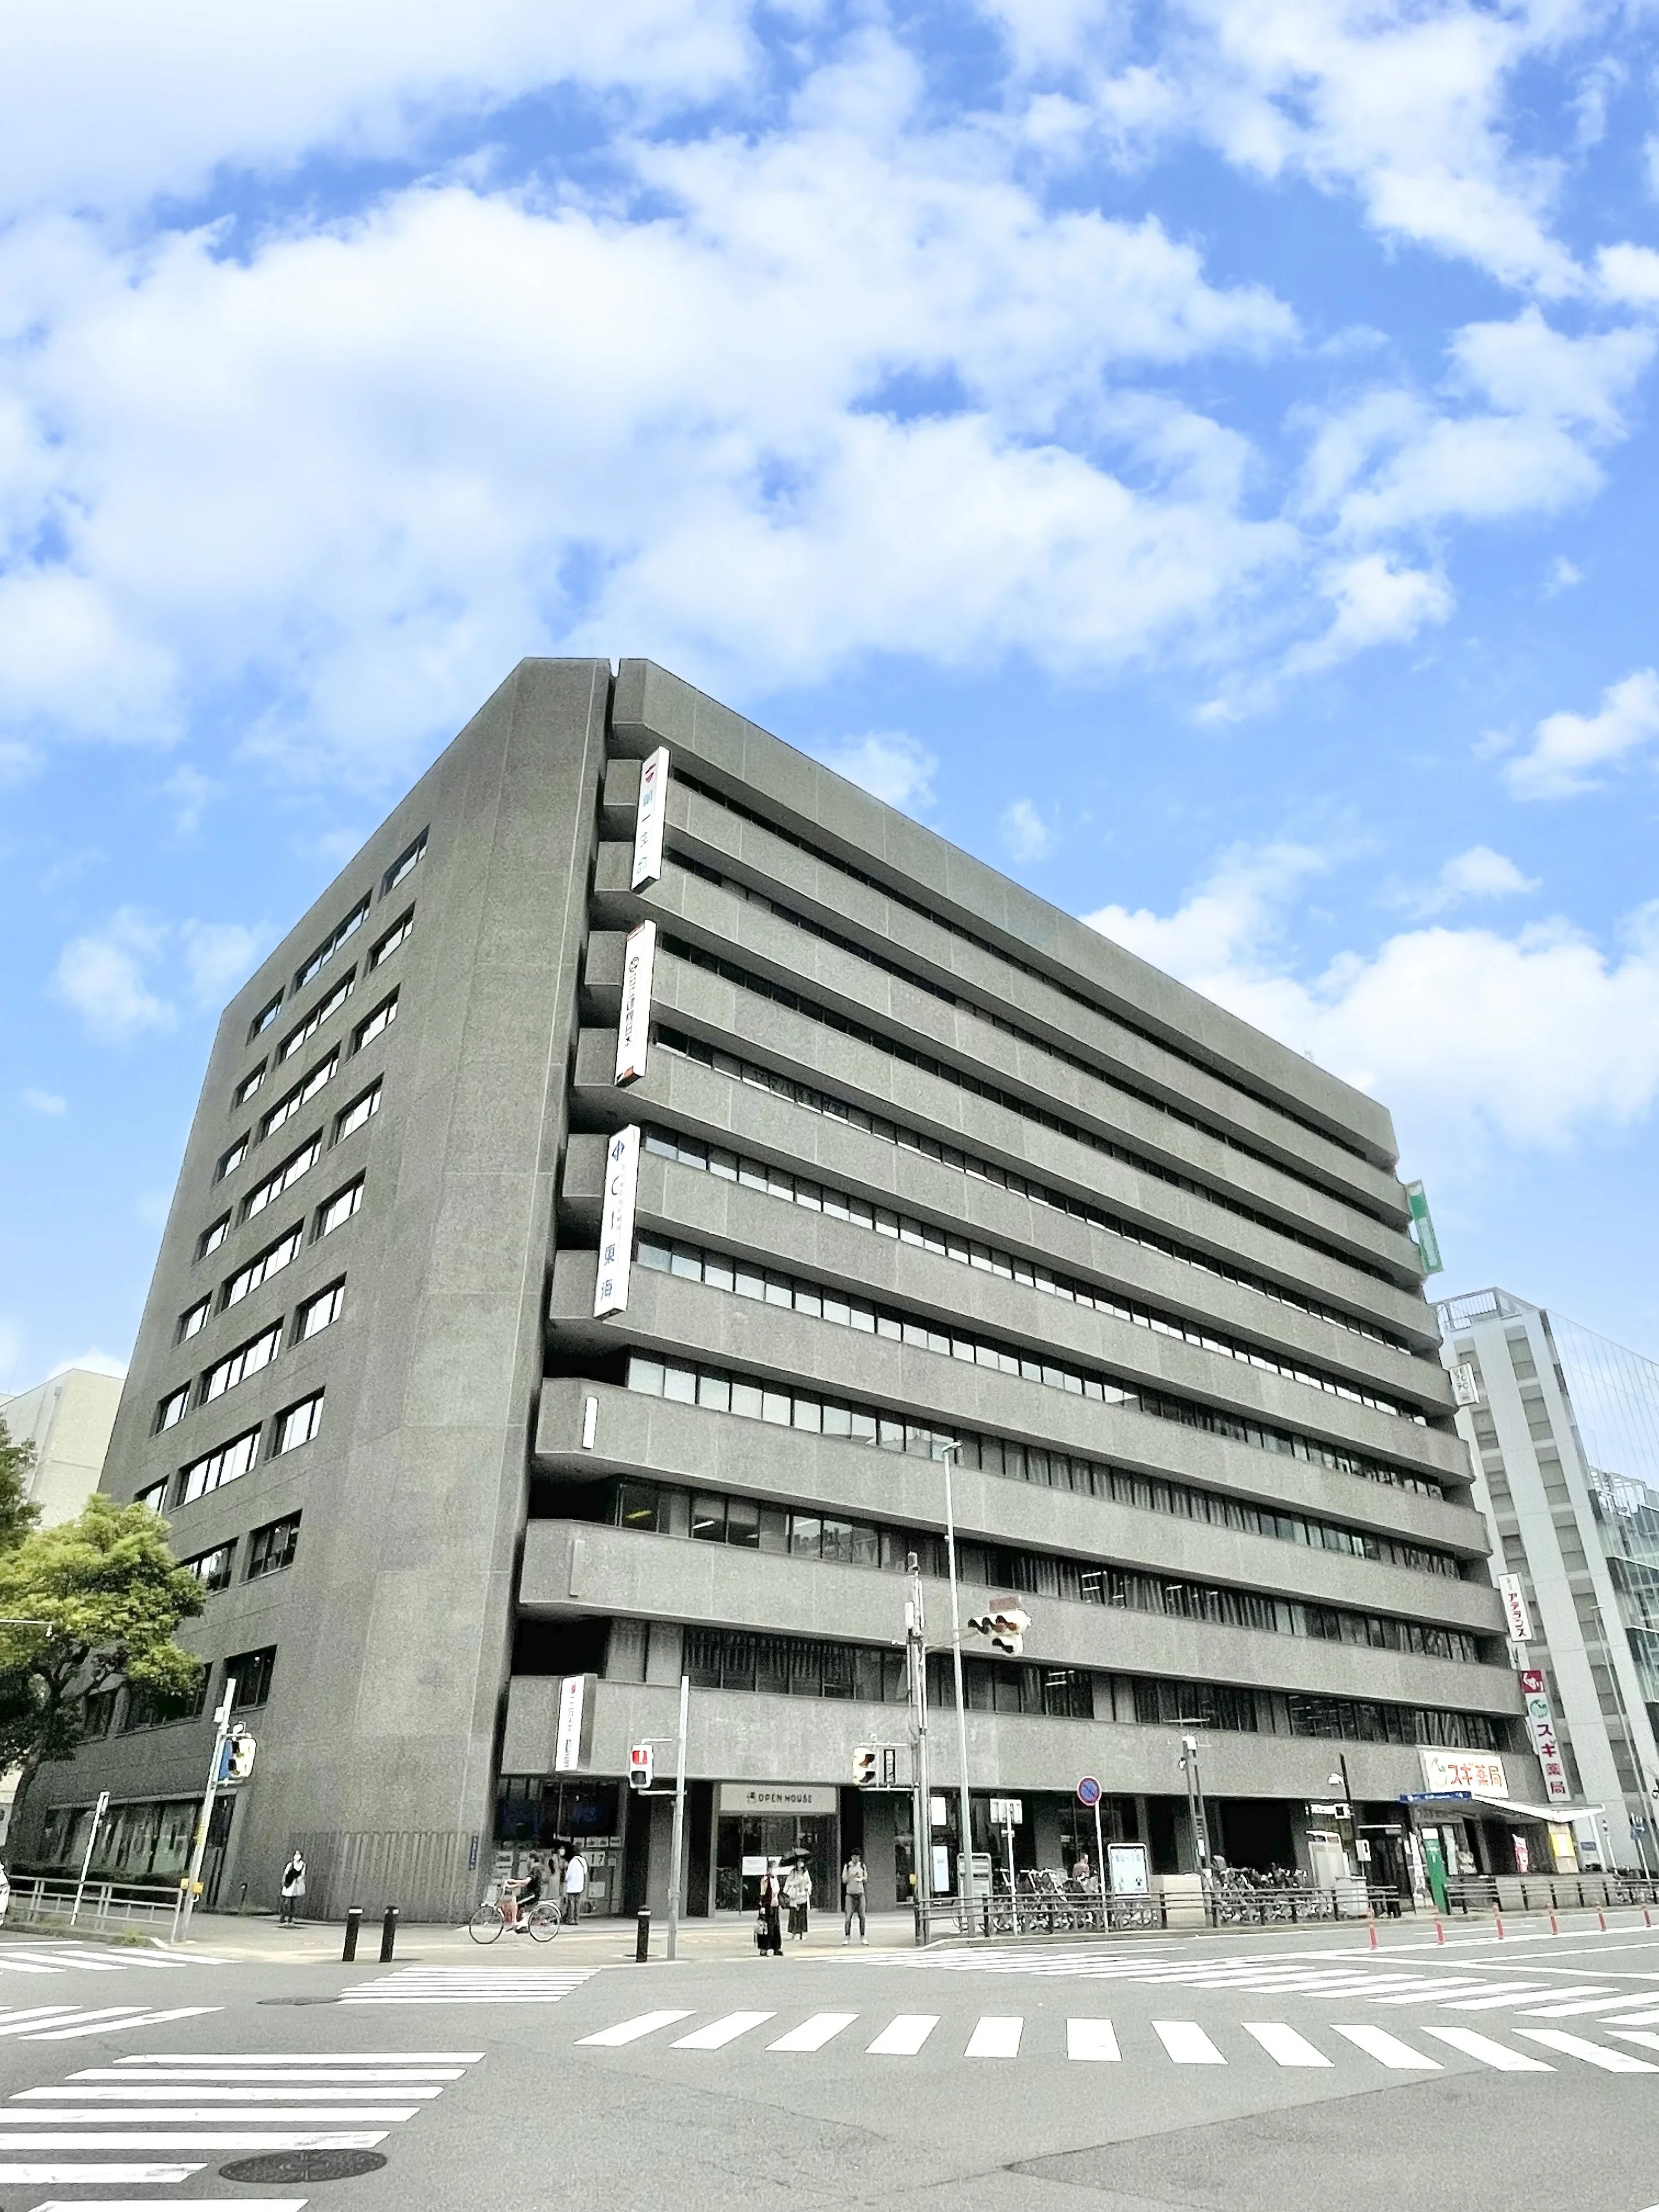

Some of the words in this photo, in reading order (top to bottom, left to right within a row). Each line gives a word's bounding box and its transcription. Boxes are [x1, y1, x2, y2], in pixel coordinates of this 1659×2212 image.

[1536, 1724, 1566, 1795] スギ薬局
[1448, 1762, 1502, 1787] スギ薬局
[758, 1794, 782, 1803] OPEN
[785, 1794, 812, 1803] HOUSE
